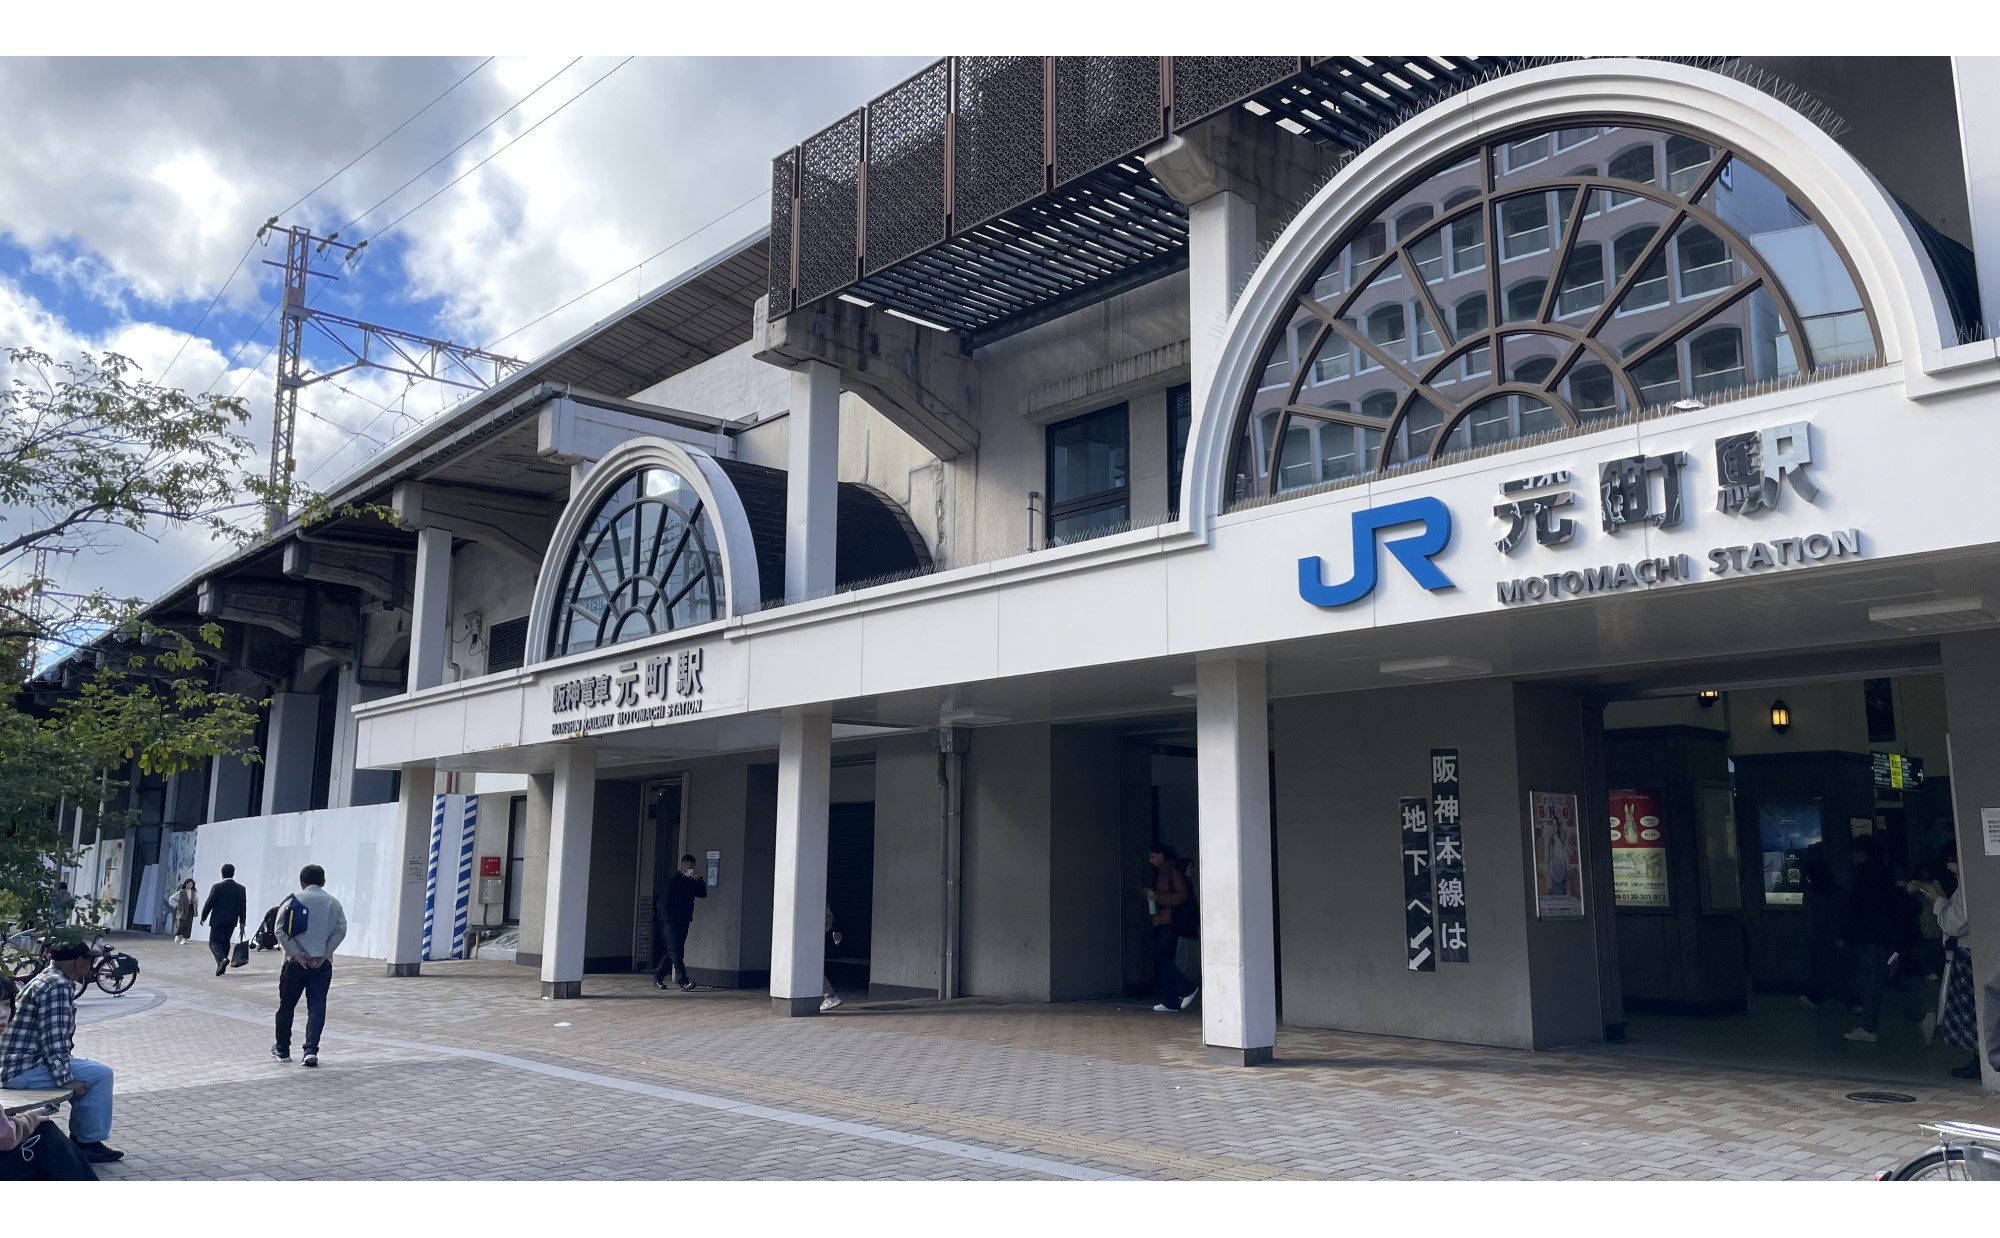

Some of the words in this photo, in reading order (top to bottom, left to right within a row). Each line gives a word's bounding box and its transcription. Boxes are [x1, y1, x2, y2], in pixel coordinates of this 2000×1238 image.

[1493, 420, 1820, 554] 元町駅
[1298, 496, 1455, 607] JR
[1496, 553, 1690, 604] MOTOMACHI
[1707, 528, 1861, 575] STATION
[551, 718, 580, 736] HANSHIN
[582, 713, 615, 733] RAILWAY
[617, 705, 666, 726] MOTOMACHI
[667, 699, 703, 718] STATION
[552, 674, 611, 715] 阪神電車
[615, 648, 703, 708] 元町駅
[1402, 805, 1432, 915] 地下へ
[1431, 755, 1467, 950] 阪神本線は
